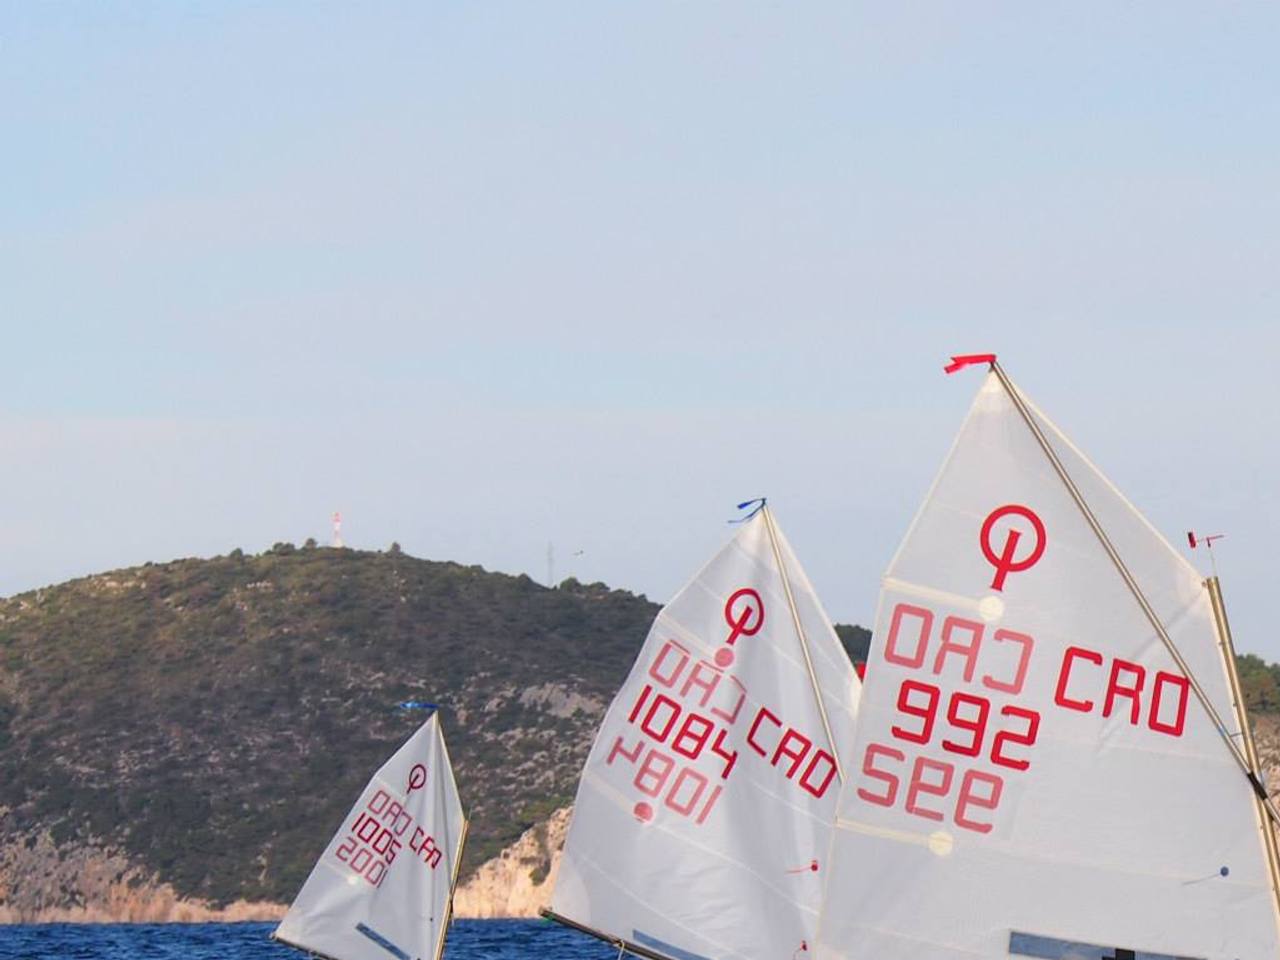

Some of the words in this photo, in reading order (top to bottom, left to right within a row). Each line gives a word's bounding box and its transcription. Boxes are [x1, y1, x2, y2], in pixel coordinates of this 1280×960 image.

[628, 685, 738, 779] 1084
[891, 679, 1040, 771] 992
[1055, 646, 1190, 737] CRO
[747, 706, 838, 799] CRO
[352, 811, 402, 866] 1005
